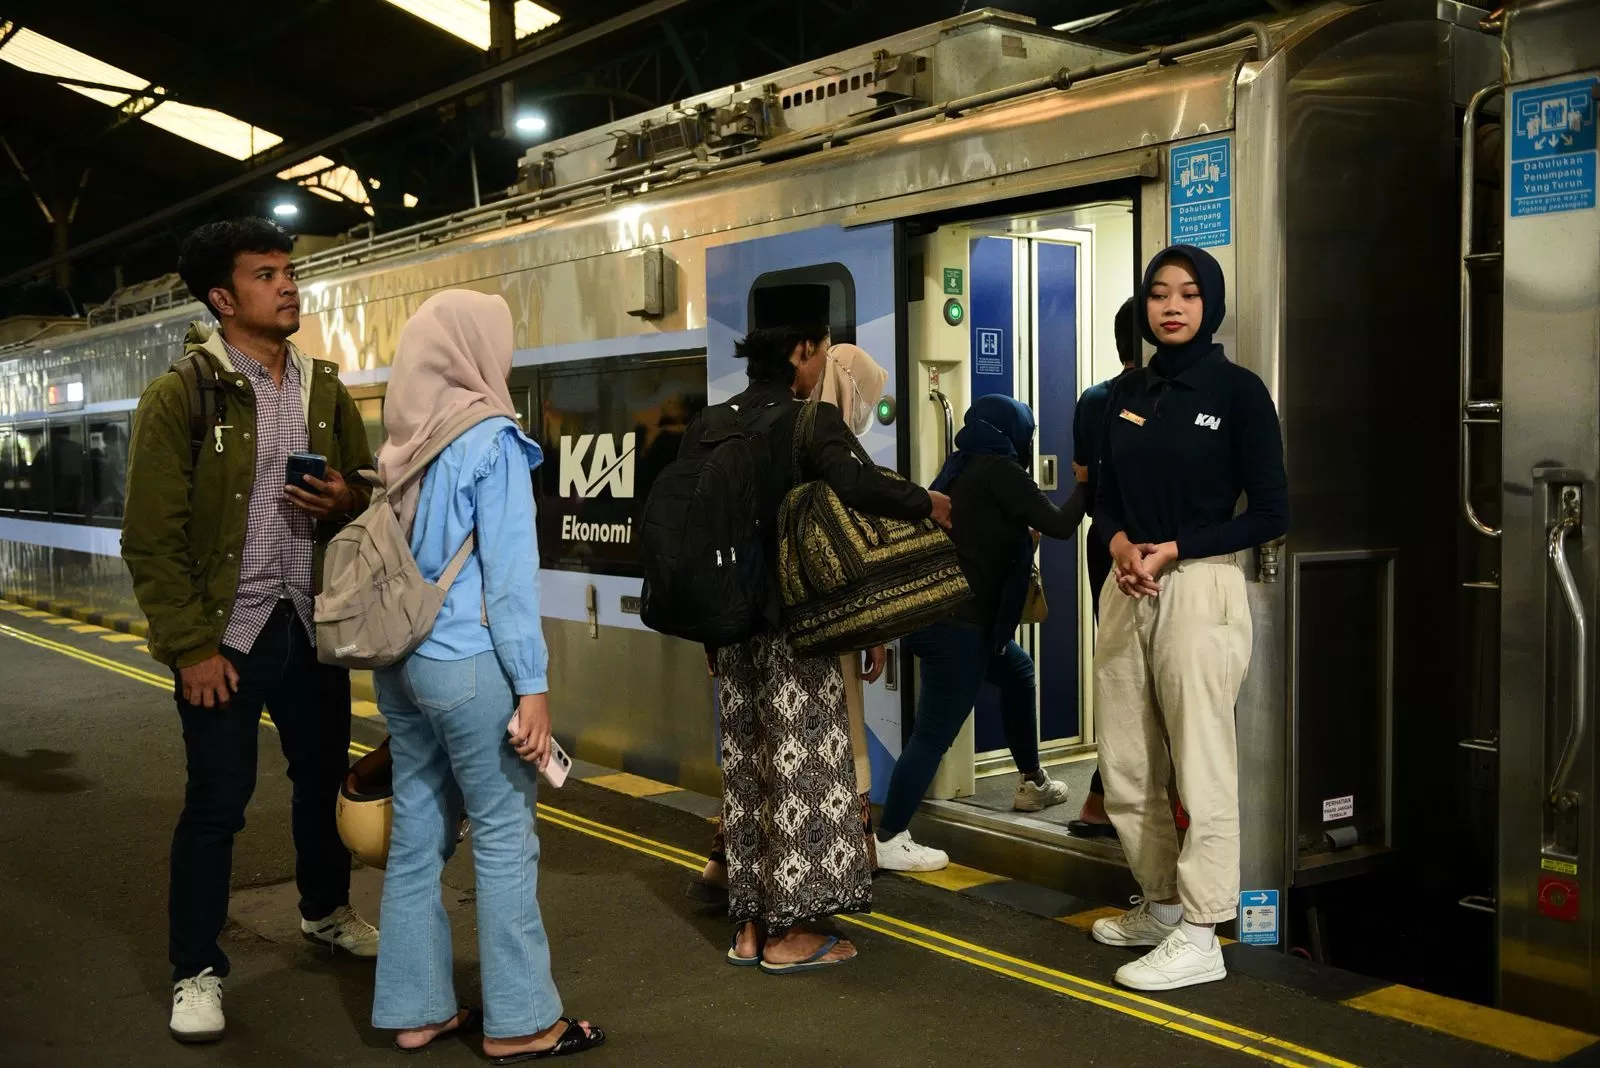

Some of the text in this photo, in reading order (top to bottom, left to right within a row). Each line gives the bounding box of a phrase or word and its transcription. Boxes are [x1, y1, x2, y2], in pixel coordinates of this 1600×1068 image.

[1523, 157, 1583, 171] Dahulukan
[1523, 168, 1583, 182] Penumpang
[1524, 179, 1583, 193] Yang Turun
[1545, 196, 1561, 204] give
[1563, 194, 1578, 202] way
[1179, 203, 1222, 214] Dahulukan
[1179, 212, 1222, 223] Penumpang
[1200, 221, 1222, 229] Turun
[1194, 412, 1222, 431] KAI
[559, 432, 636, 498] KAI
[561, 515, 632, 543] Ekonomi
